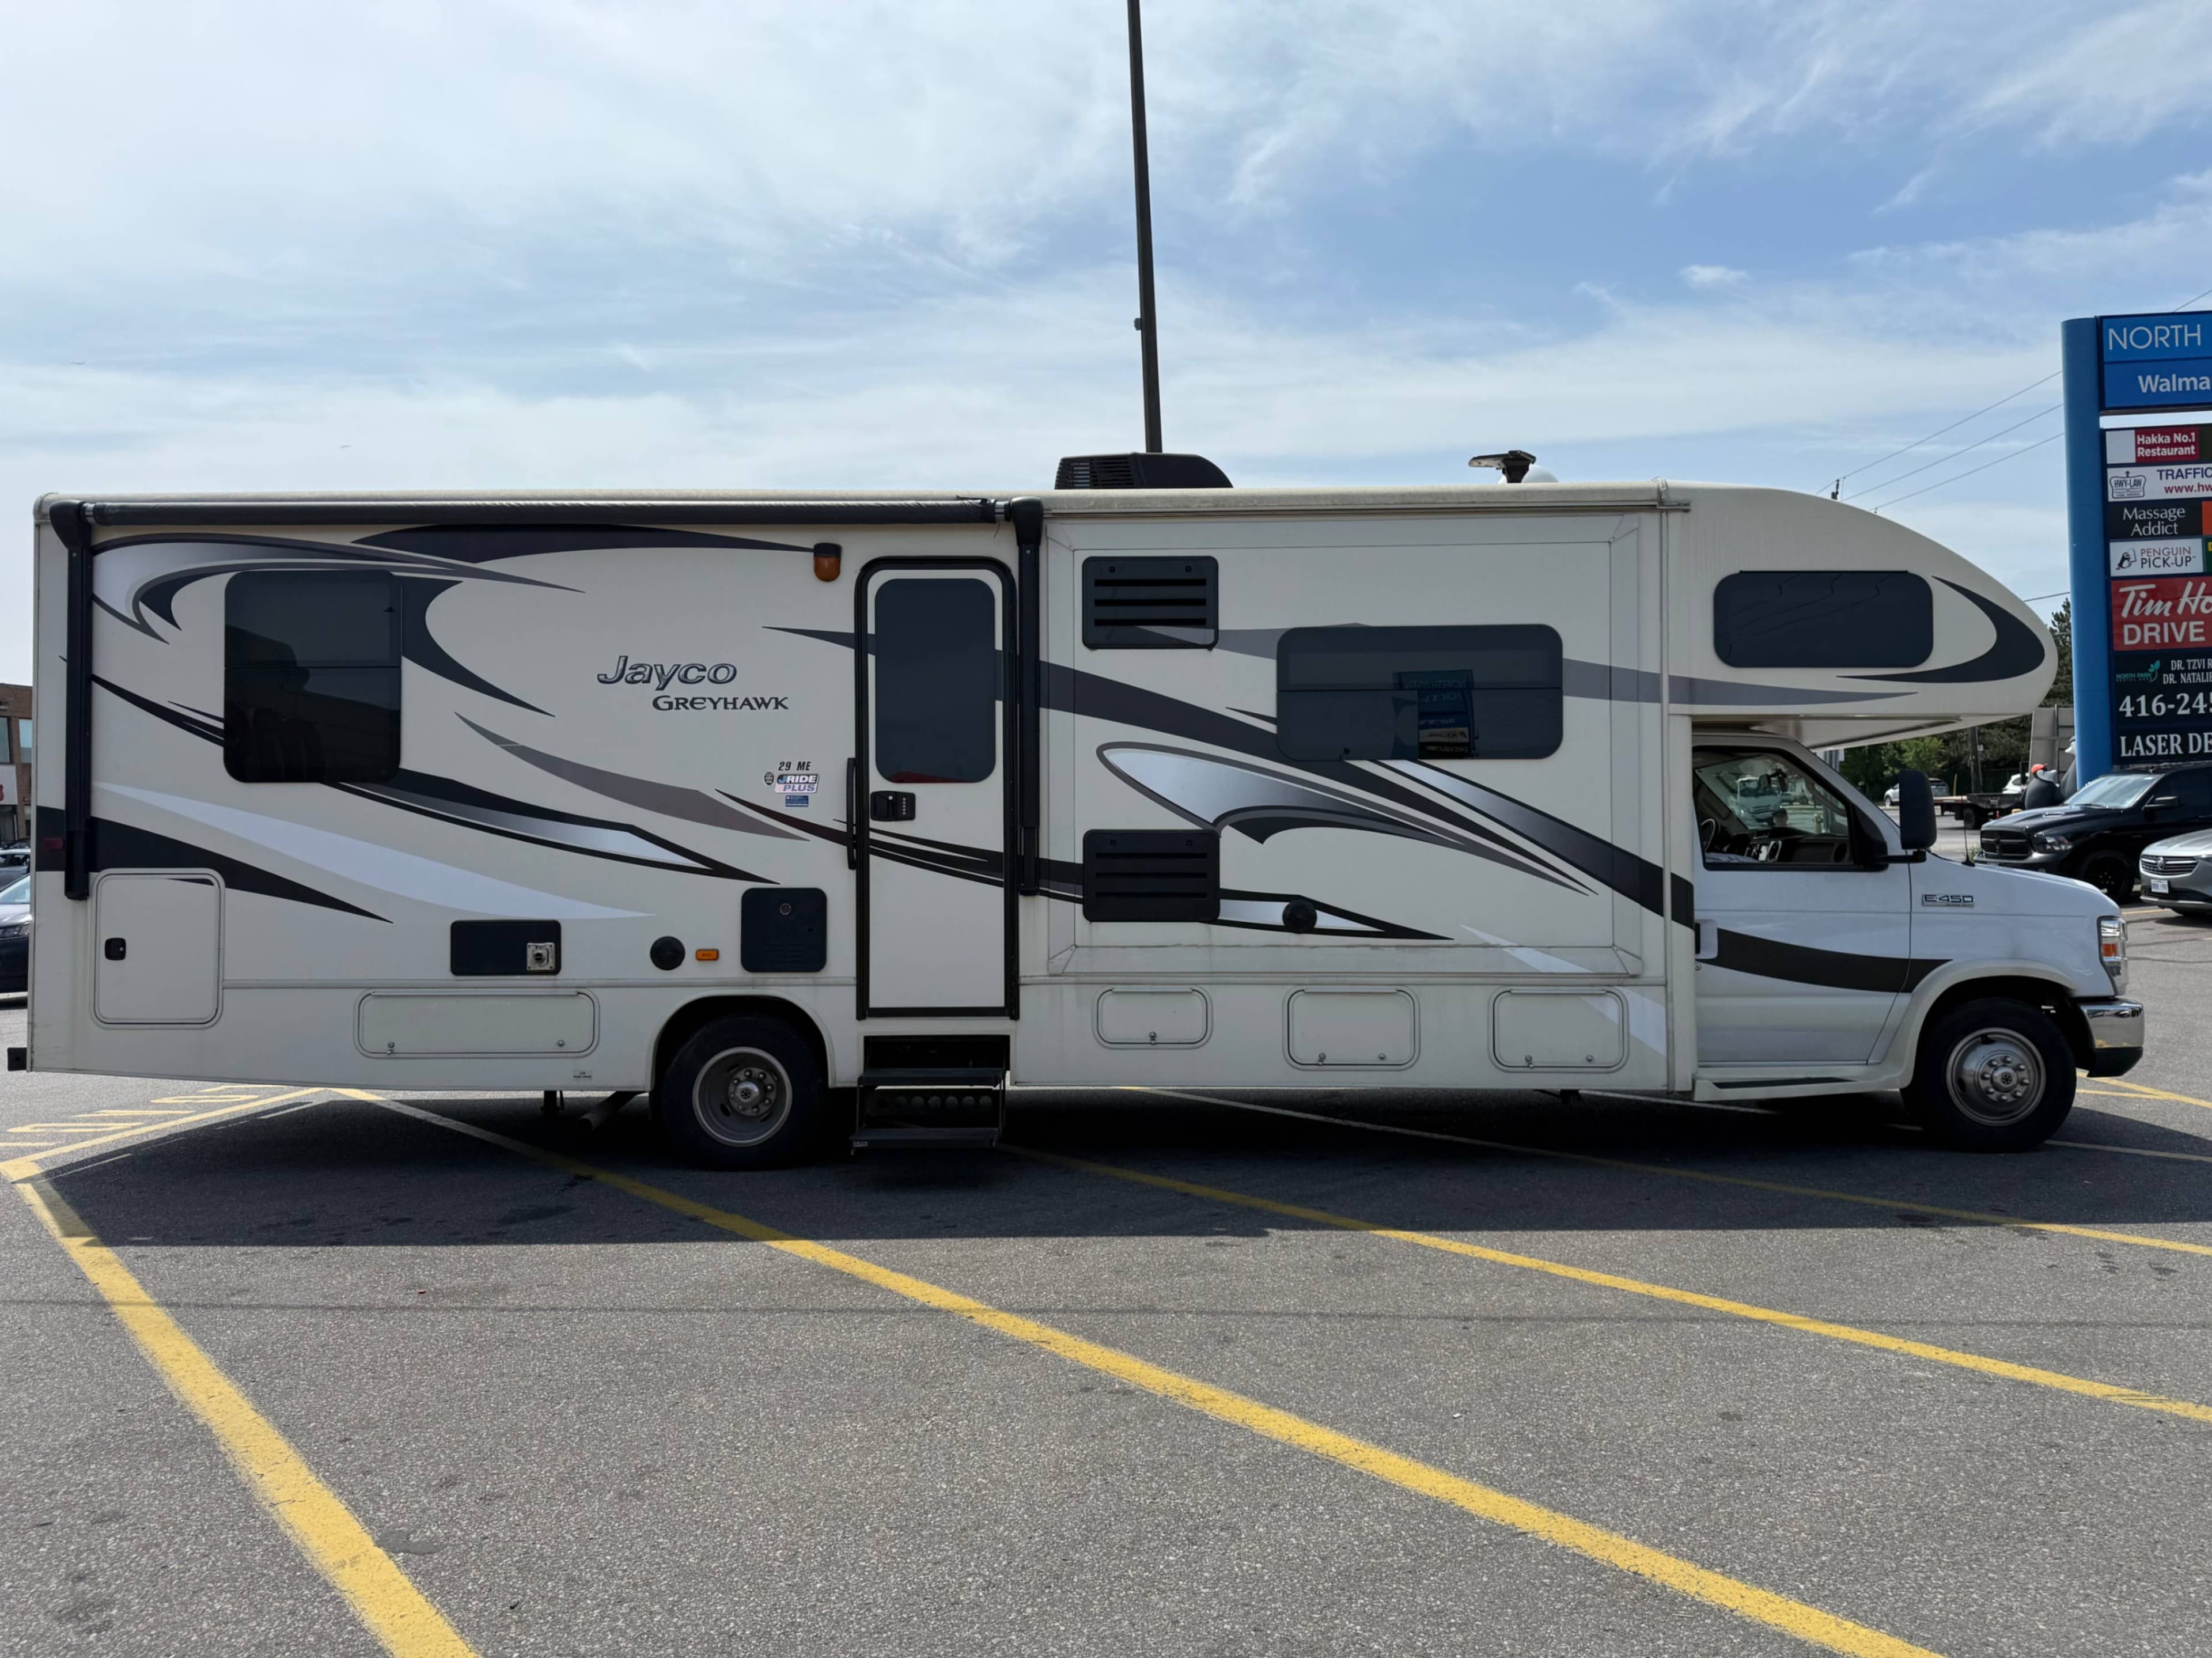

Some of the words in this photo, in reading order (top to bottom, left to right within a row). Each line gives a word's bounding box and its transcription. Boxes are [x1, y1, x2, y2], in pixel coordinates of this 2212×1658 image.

[2108, 323, 2202, 351] NORTH
[2137, 433, 2171, 445] Hakka
[2173, 432, 2196, 443] No.1
[2137, 445, 2196, 457] Restaurant
[2123, 507, 2186, 521] Massage
[2131, 521, 2179, 536] Addict
[2140, 547, 2192, 557] PENGUIN
[2119, 584, 2172, 618] Tim
[2123, 621, 2206, 645] DRIVE
[2171, 660, 2185, 671] DR.
[2186, 658, 2205, 669] TZVI
[597, 655, 737, 691] Jayco
[2163, 673, 2177, 684] DR.
[652, 695, 789, 711] GREYHAWK
[2119, 692, 2212, 717] 416-24
[2120, 733, 2183, 757] LASER
[778, 761, 791, 771] 29
[797, 761, 812, 771] ME
